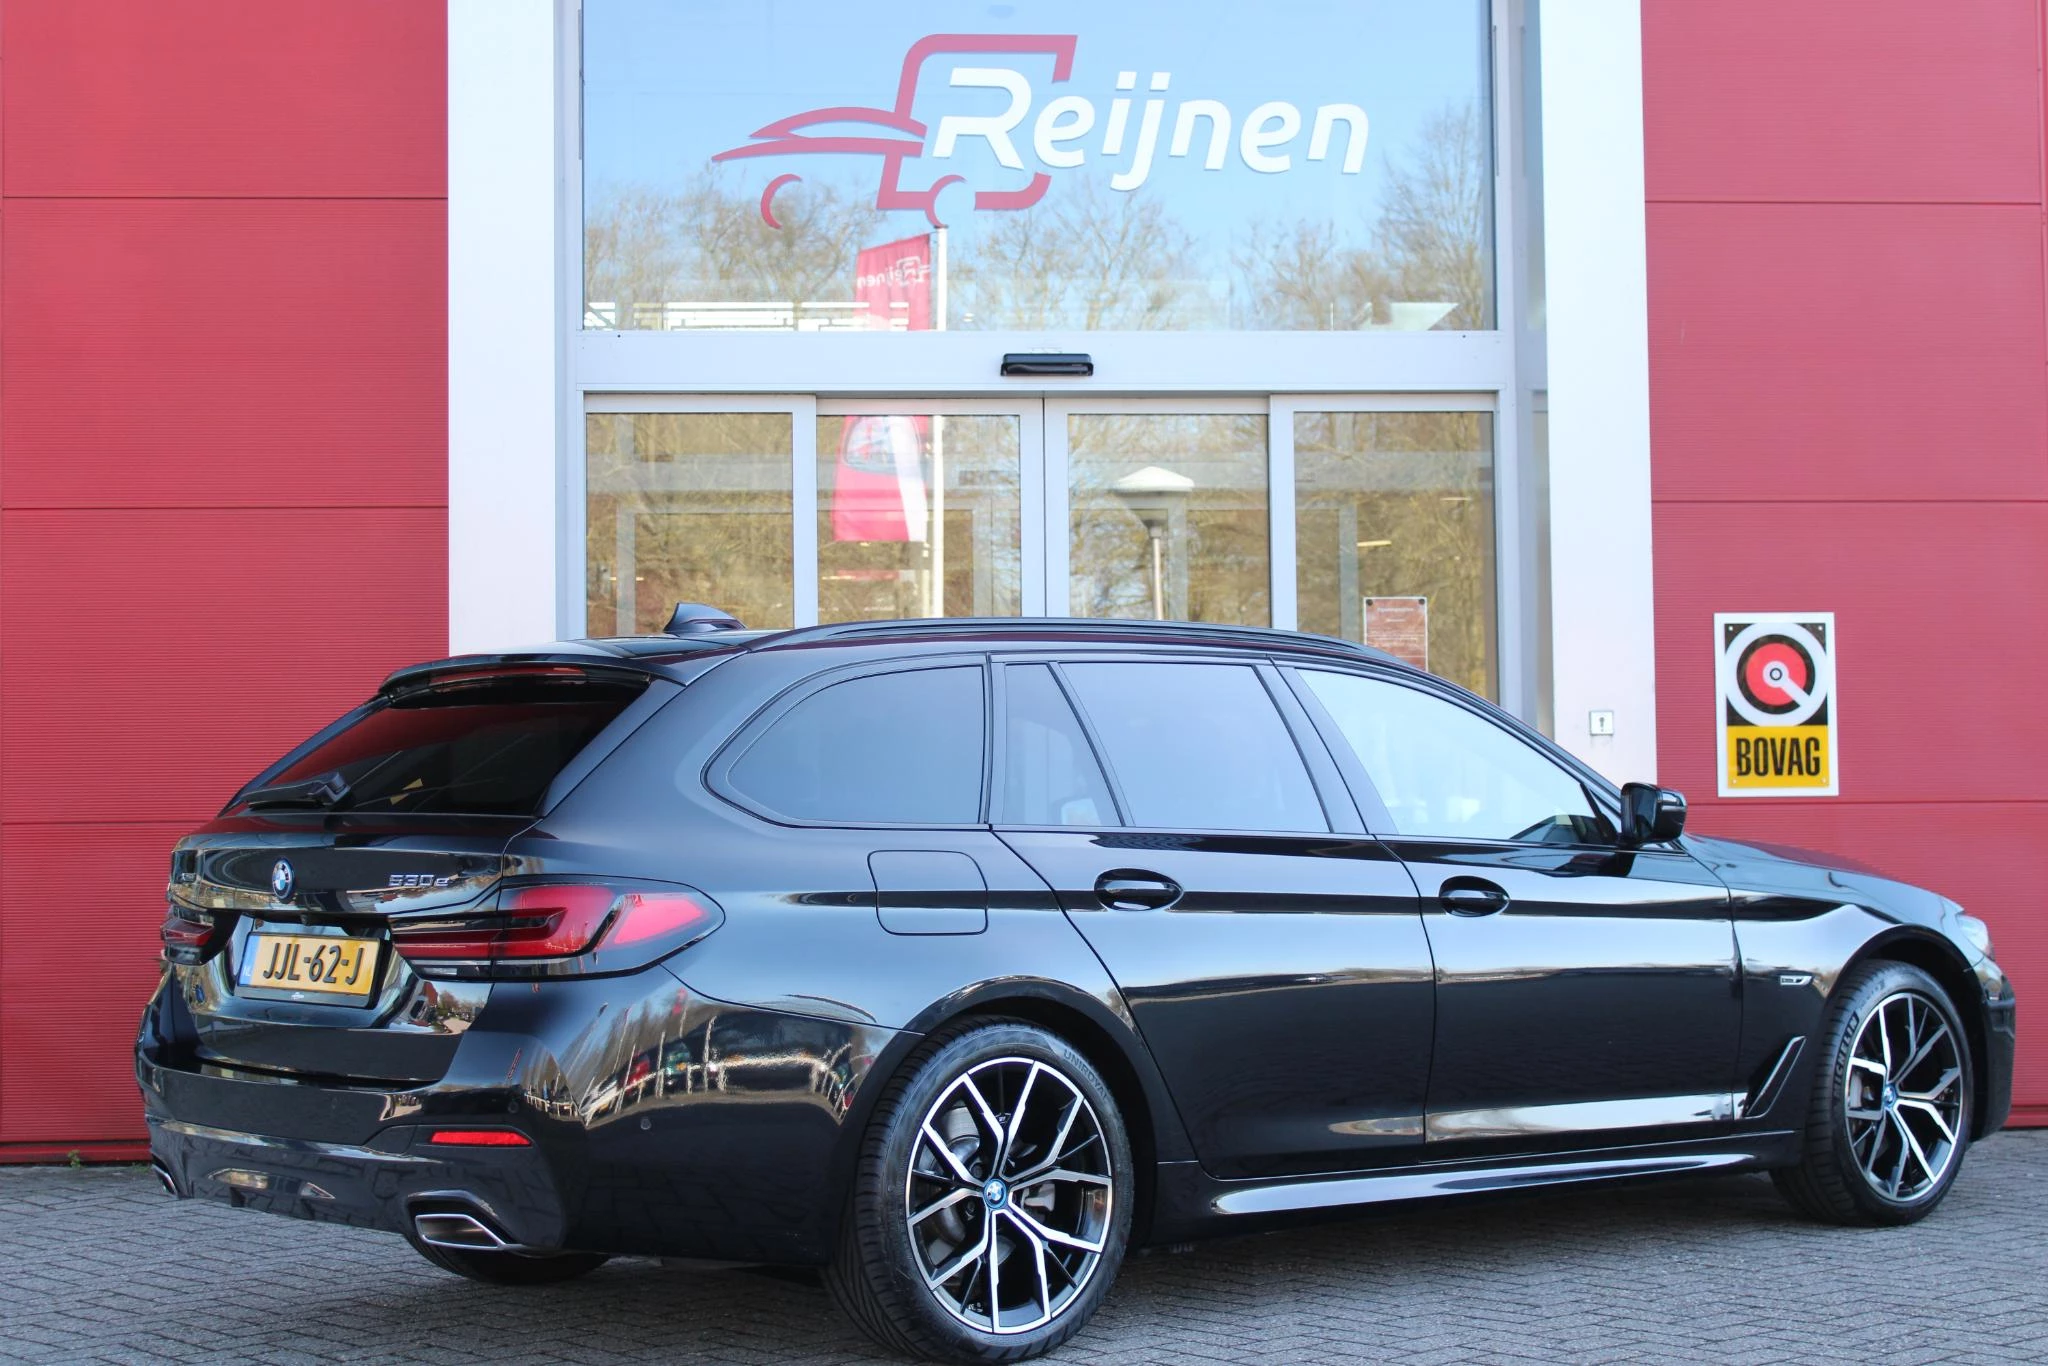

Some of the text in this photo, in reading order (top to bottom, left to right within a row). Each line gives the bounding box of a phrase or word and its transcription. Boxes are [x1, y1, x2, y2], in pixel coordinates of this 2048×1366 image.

[932, 67, 1369, 191] Reijnen
[1736, 737, 1821, 777] BOVAG
[388, 874, 450, 887] 530e
[262, 942, 365, 986] JJL-62-J
